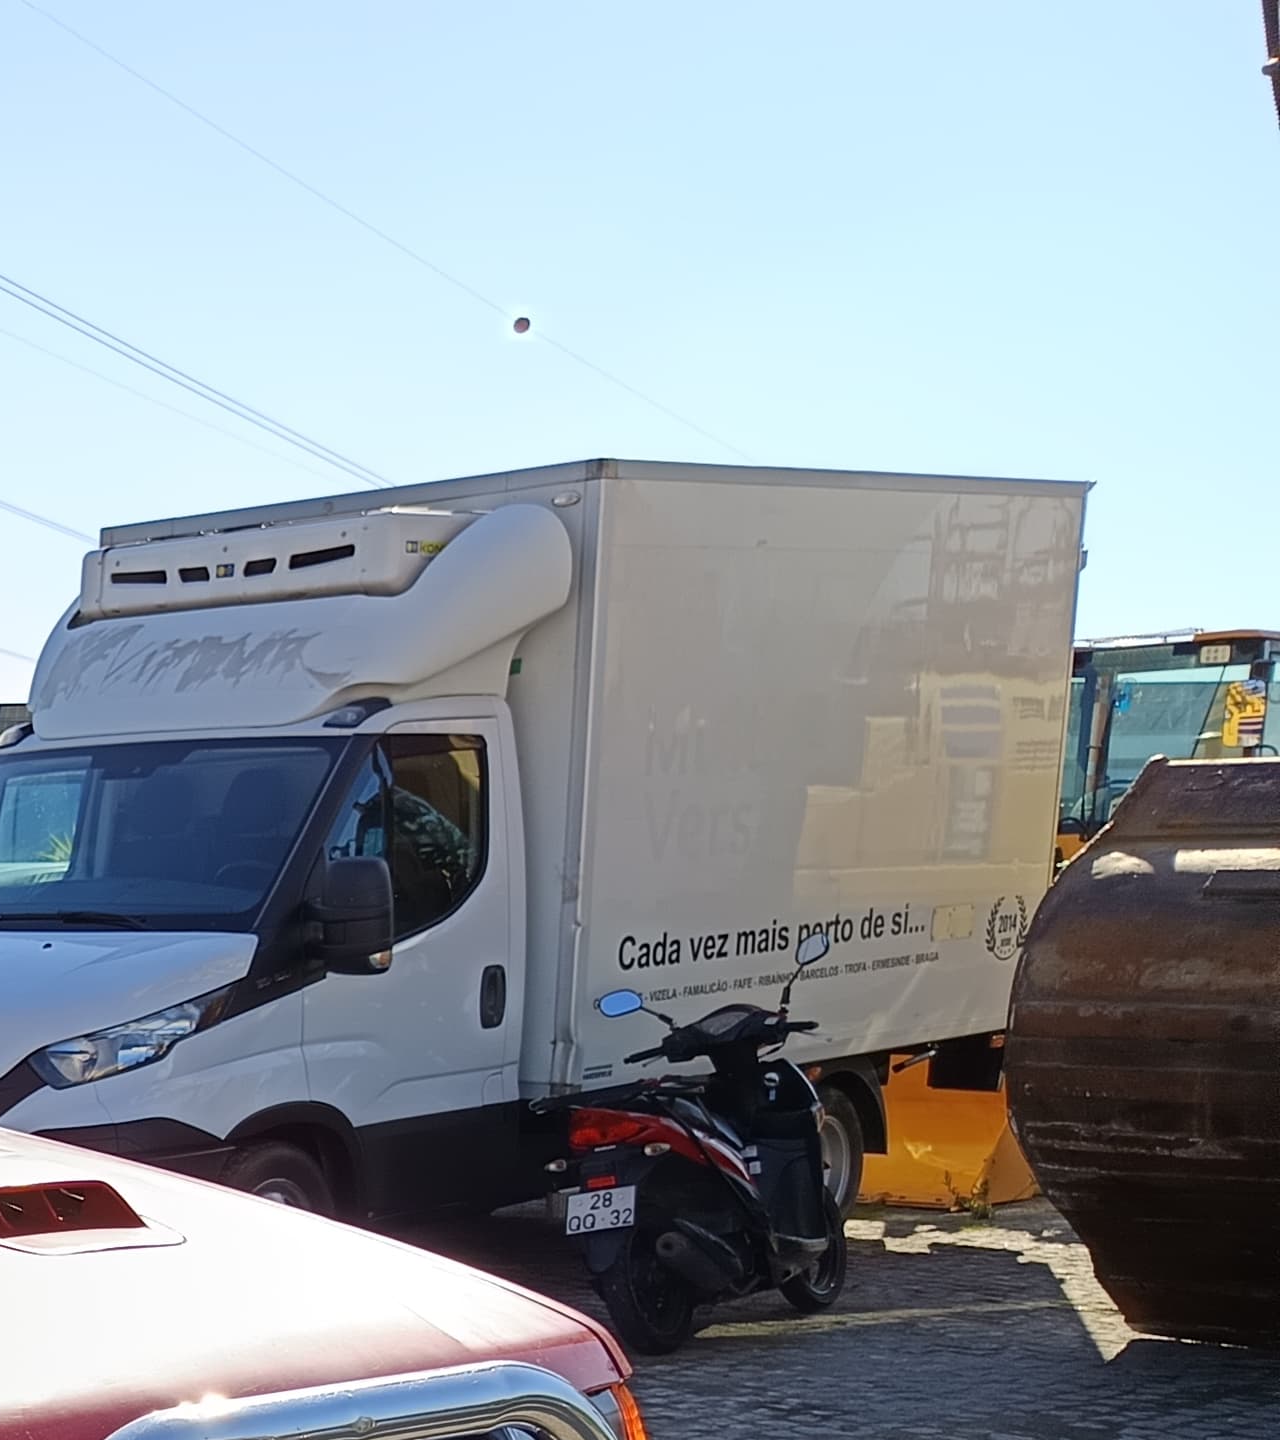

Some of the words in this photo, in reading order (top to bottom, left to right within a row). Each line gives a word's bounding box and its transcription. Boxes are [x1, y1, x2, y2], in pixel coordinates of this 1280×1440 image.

[998, 913, 1018, 933] 2014
[618, 932, 681, 970] Cada
[690, 932, 729, 962] vez
[735, 919, 790, 956] mais
[860, 907, 885, 939] de
[590, 1191, 612, 1210] 28
